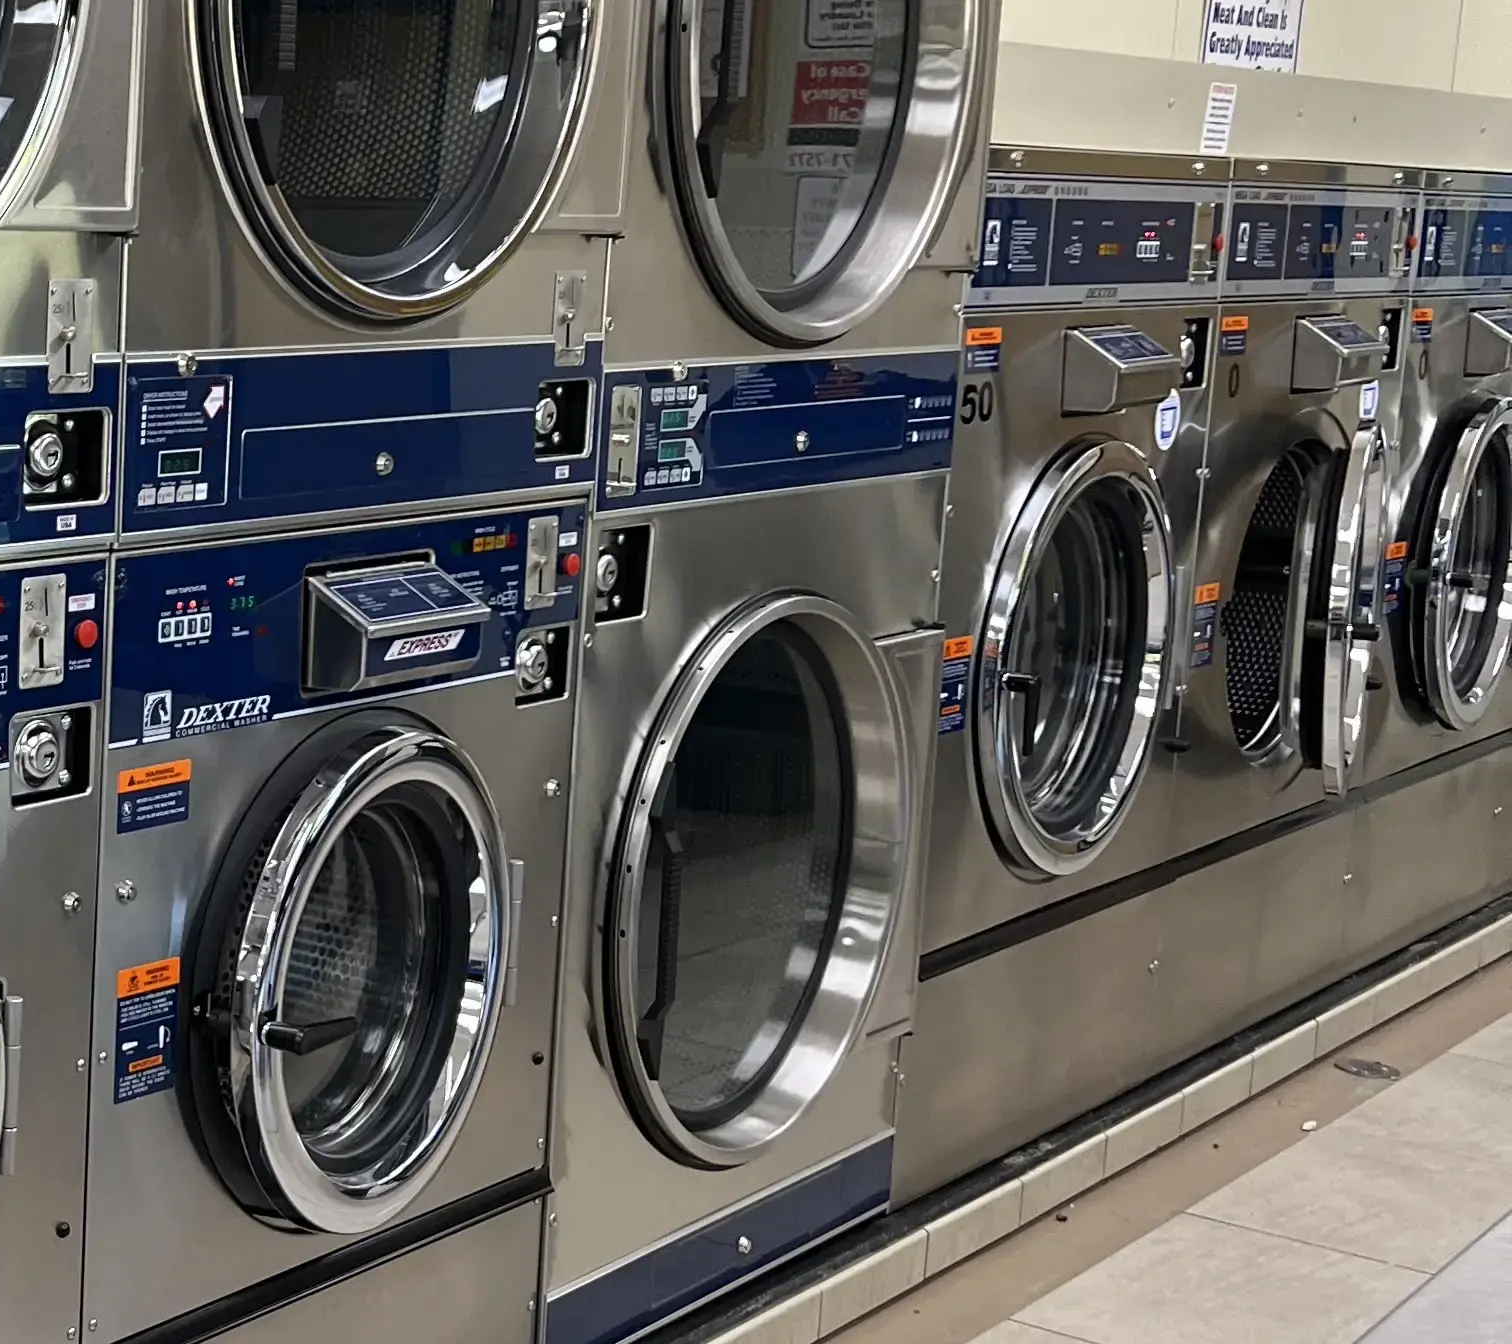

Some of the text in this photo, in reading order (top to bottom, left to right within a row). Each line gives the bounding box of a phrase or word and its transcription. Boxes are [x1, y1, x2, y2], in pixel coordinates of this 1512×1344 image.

[1213, 2, 1287, 30] Neat And Clean Is
[1209, 31, 1294, 61] Greatly Appreciated
[960, 381, 994, 425] 50
[398, 633, 452, 656] EXPRESS
[176, 695, 270, 729] DEXTER
[176, 715, 268, 737] COMMERCIAL WASHER
